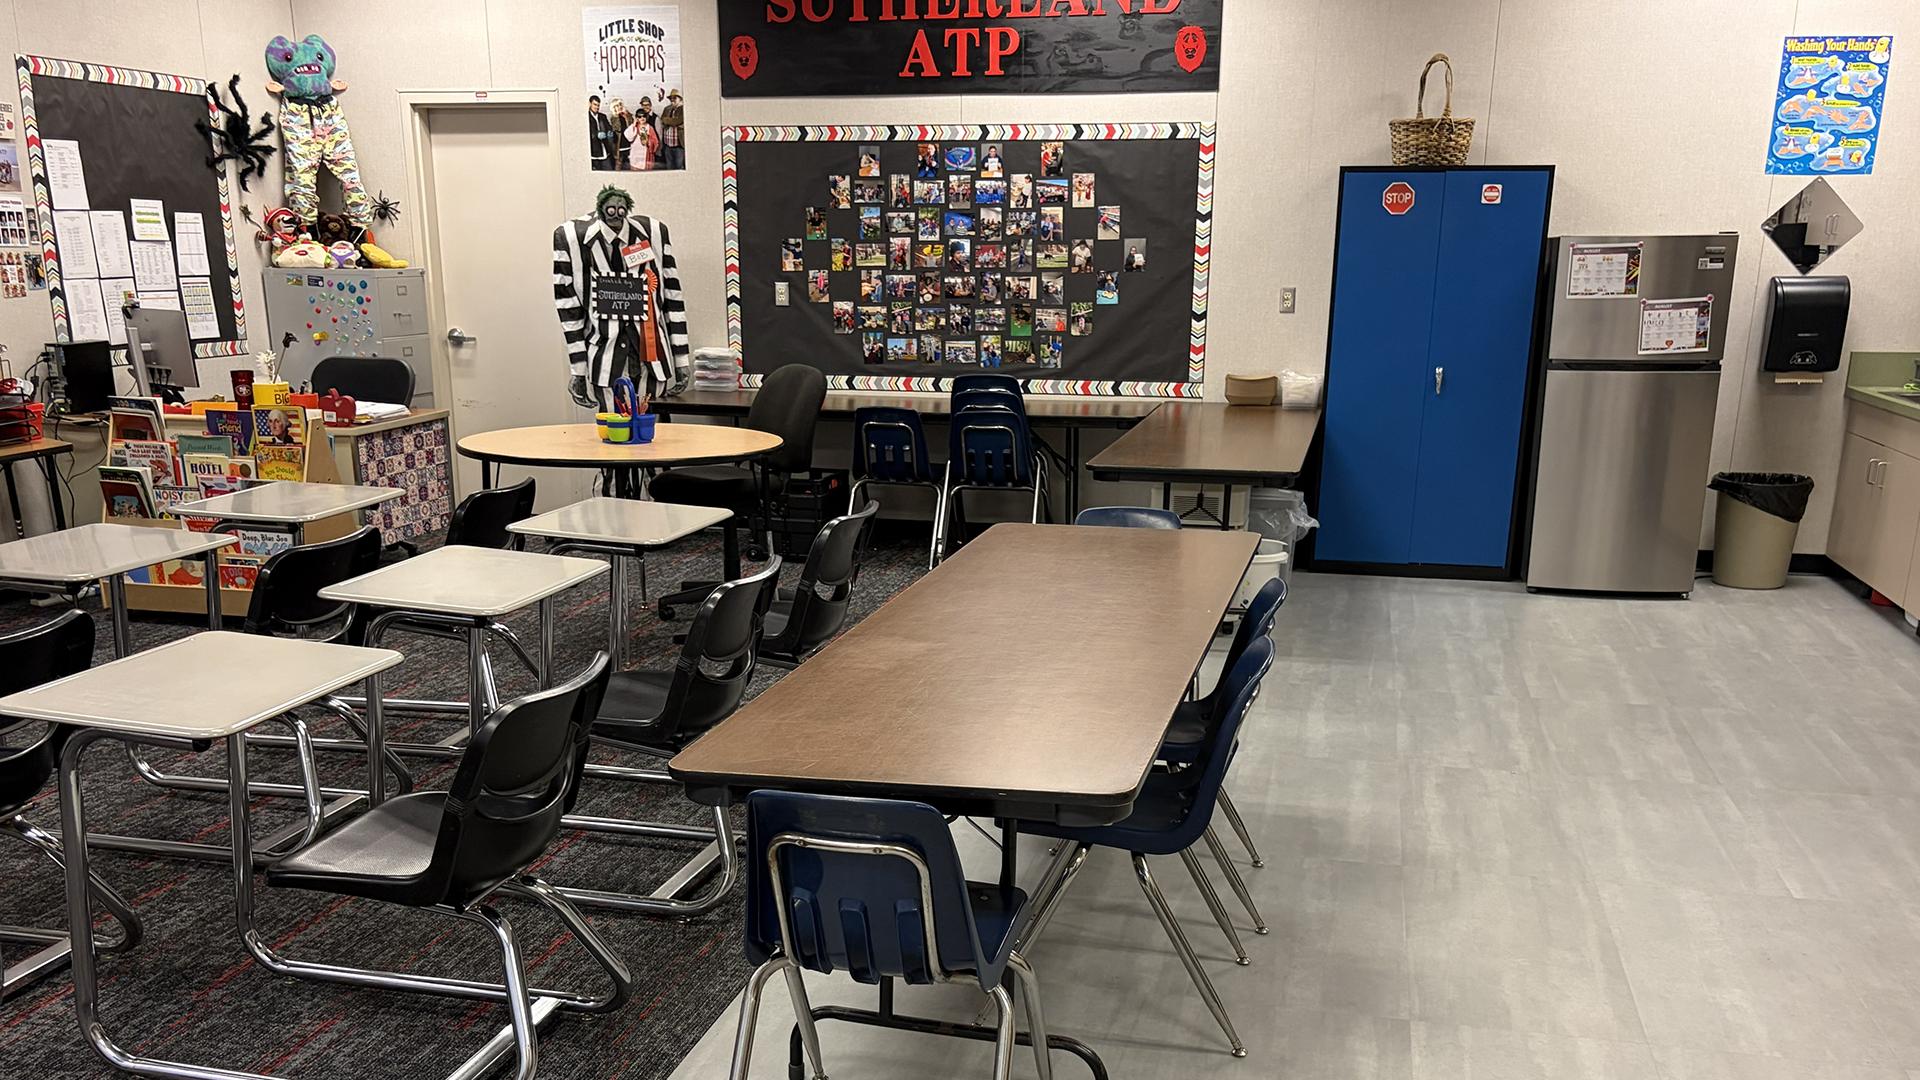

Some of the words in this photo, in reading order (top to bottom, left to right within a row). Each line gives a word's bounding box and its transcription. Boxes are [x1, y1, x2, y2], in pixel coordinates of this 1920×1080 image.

[599, 19, 635, 42] LITTLE
[638, 20, 665, 41] SHOP
[899, 26, 1020, 77] ATP
[1787, 39, 1824, 53] Washing
[1826, 39, 1848, 52] Your
[1847, 39, 1875, 52] Hands
[599, 44, 665, 80] HORRORS
[1385, 192, 1412, 204] STOP
[598, 290, 642, 300] SUTHERLAND
[612, 301, 630, 310] ATP
[274, 393, 290, 405] BIG
[218, 422, 242, 433] Friend
[190, 463, 224, 475] HOTEL
[155, 490, 183, 501] NOISY
